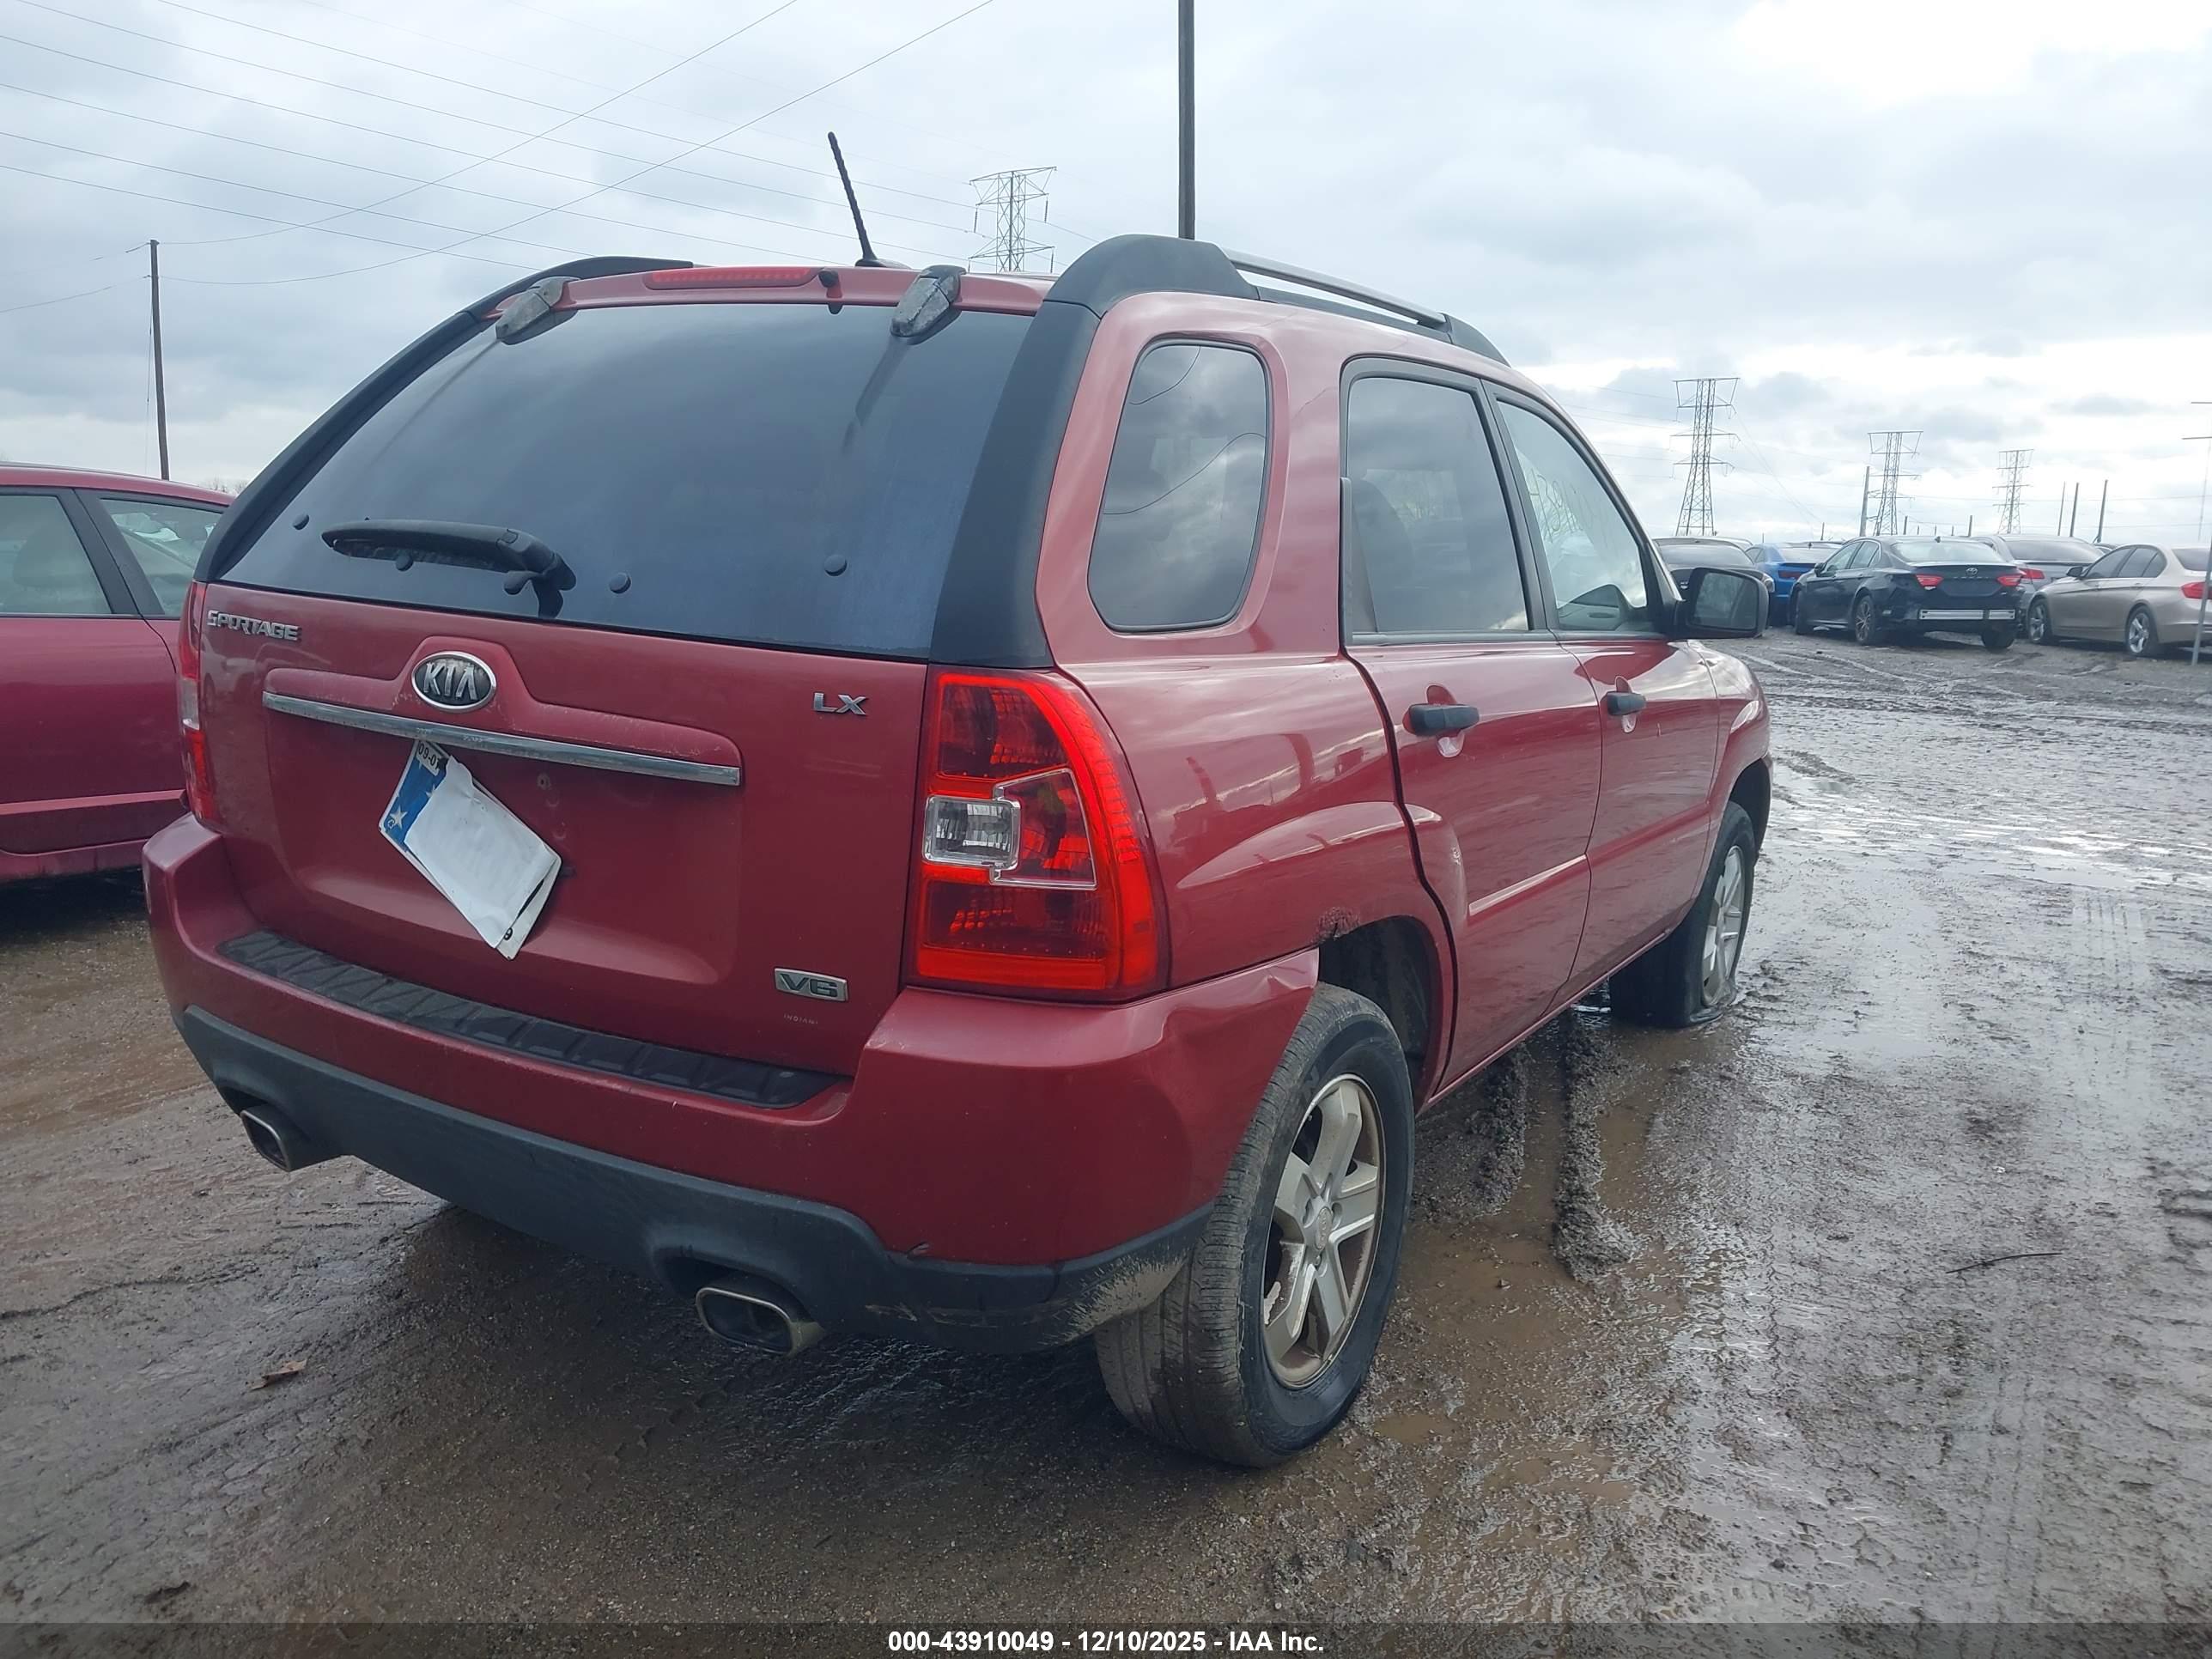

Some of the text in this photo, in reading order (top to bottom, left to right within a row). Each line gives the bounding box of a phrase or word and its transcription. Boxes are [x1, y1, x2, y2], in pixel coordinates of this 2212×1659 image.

[207, 610, 299, 641] SPORTAGE
[423, 661, 478, 701] KIA
[813, 692, 866, 715] LX
[779, 973, 839, 998] V6
